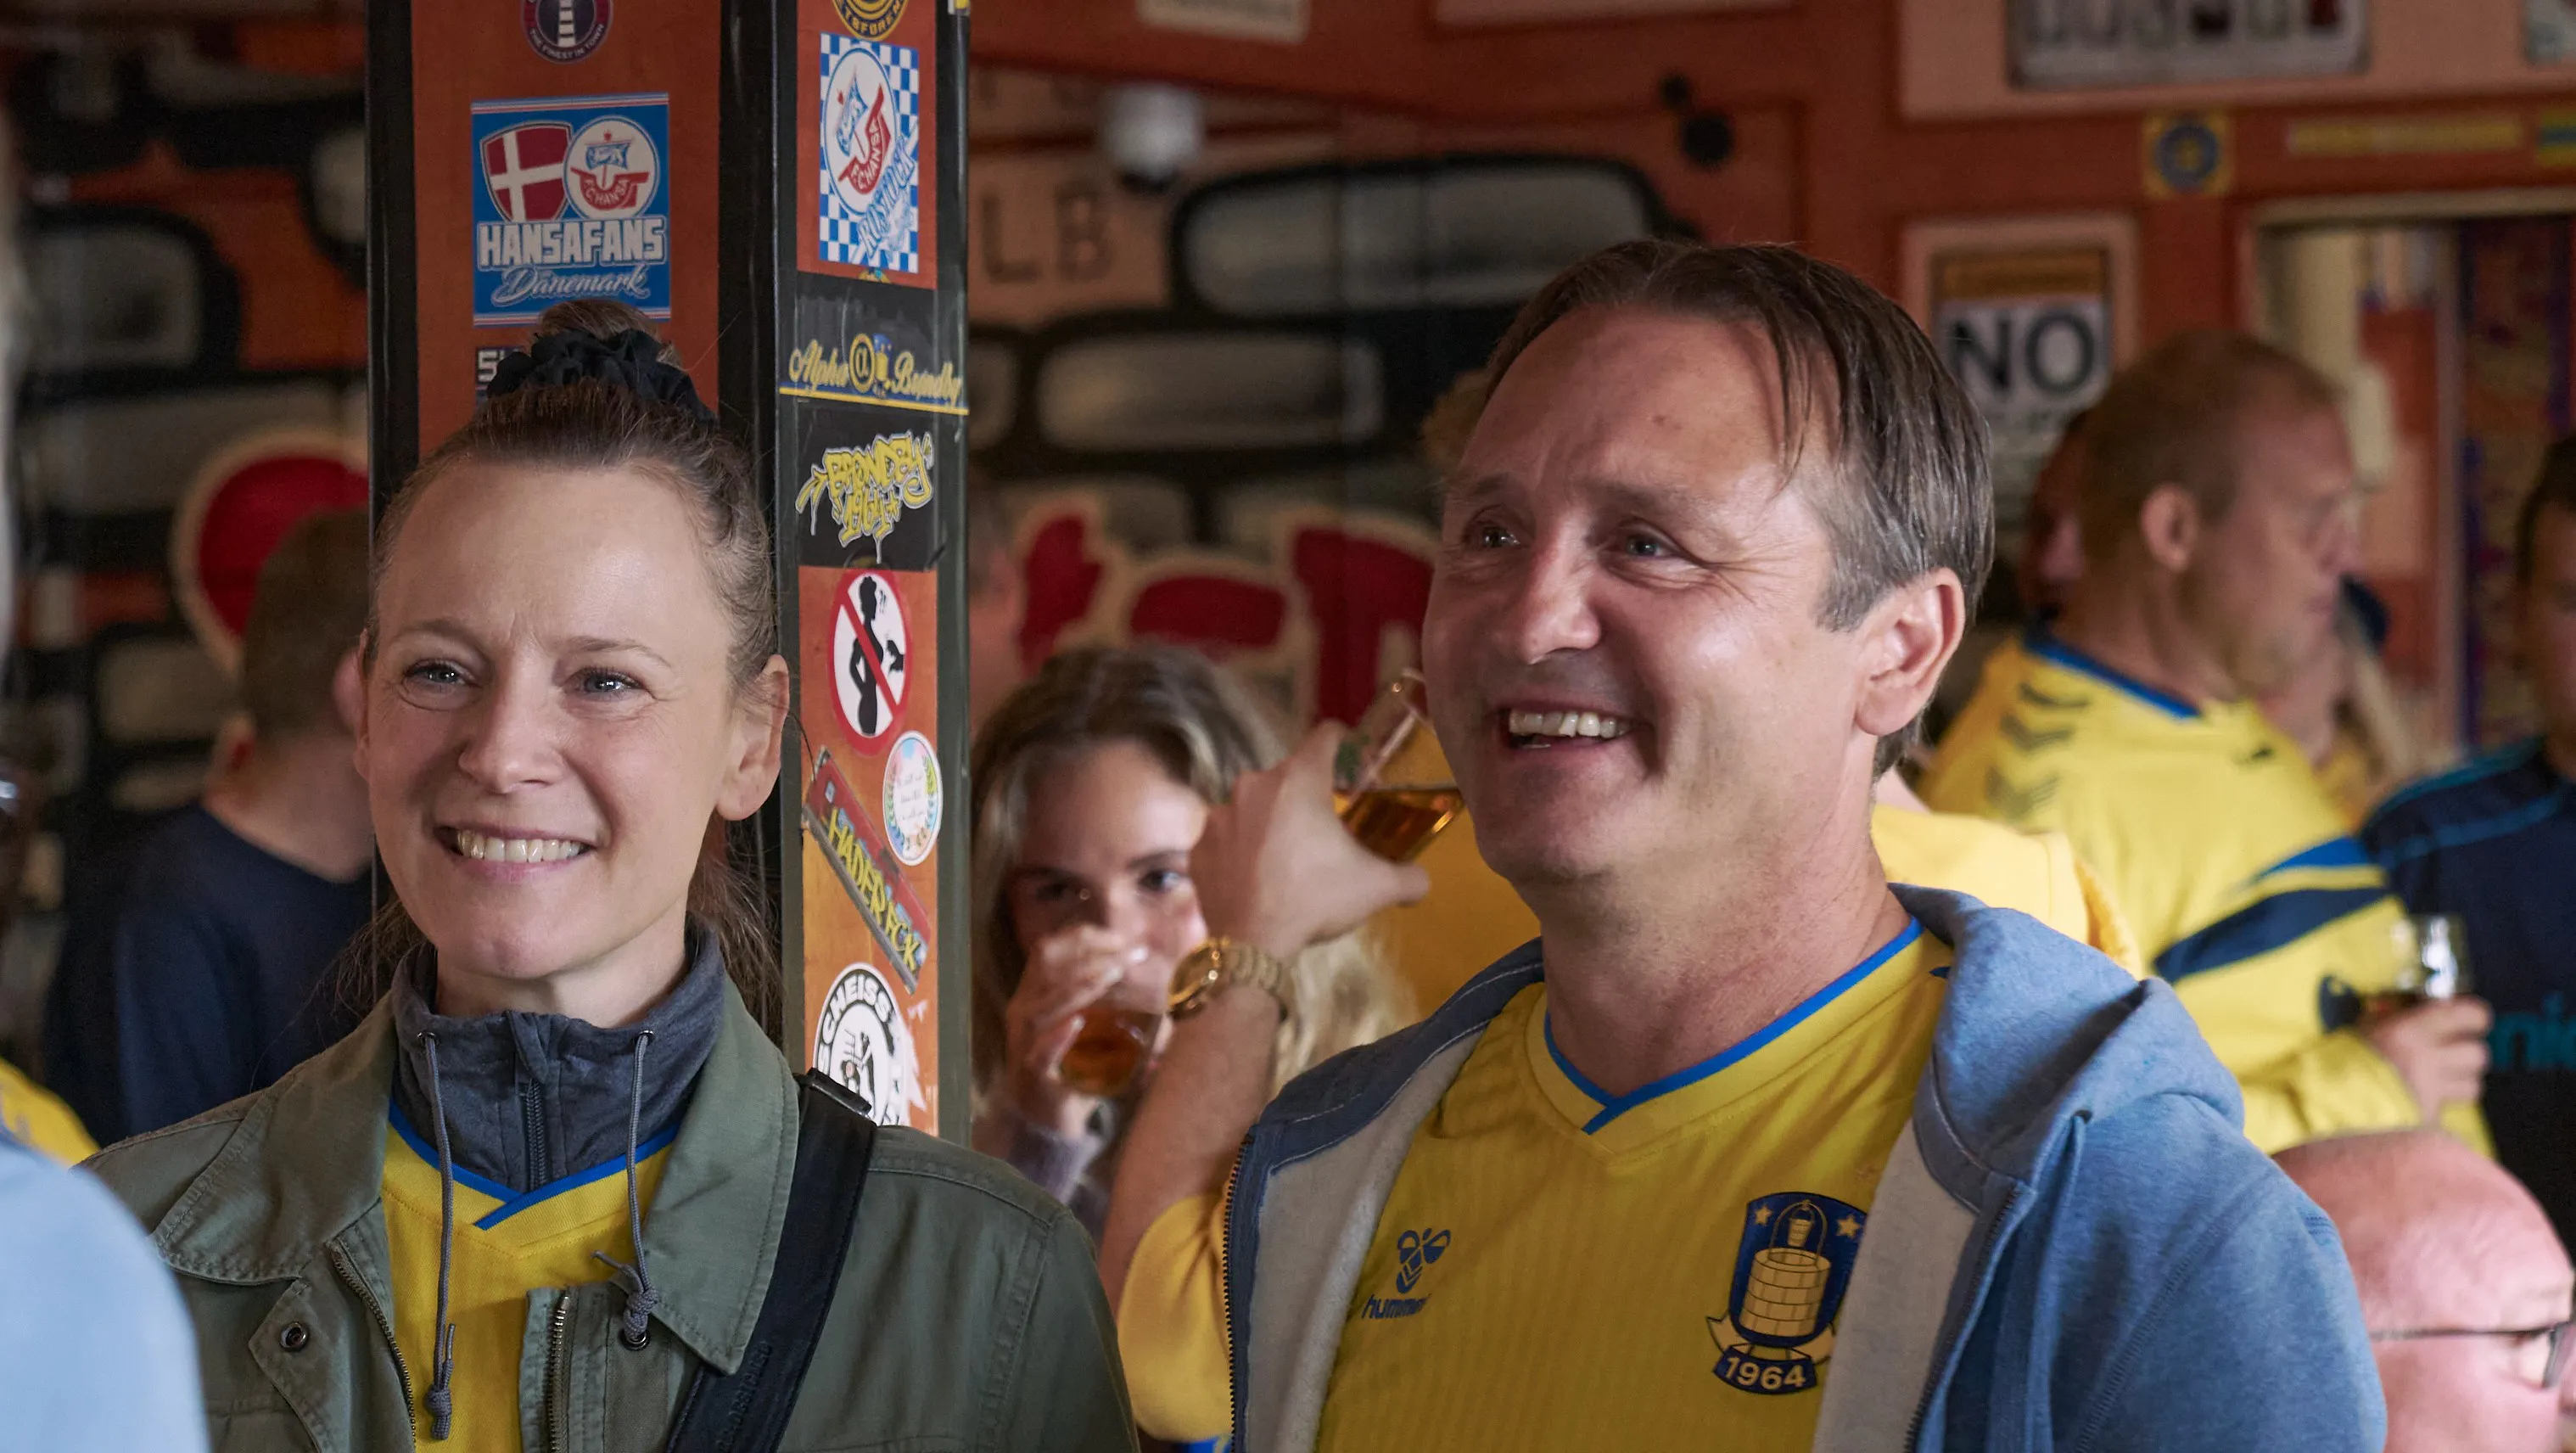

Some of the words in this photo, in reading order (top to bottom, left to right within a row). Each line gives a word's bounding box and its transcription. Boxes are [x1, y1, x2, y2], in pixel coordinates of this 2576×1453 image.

[540, 44, 574, 59] FINEST
[584, 24, 605, 49] TOWN
[477, 217, 667, 270] HANSAFANS
[788, 339, 849, 394] Alpha
[1948, 308, 2096, 397] NO
[1722, 1356, 1807, 1391] 1964
